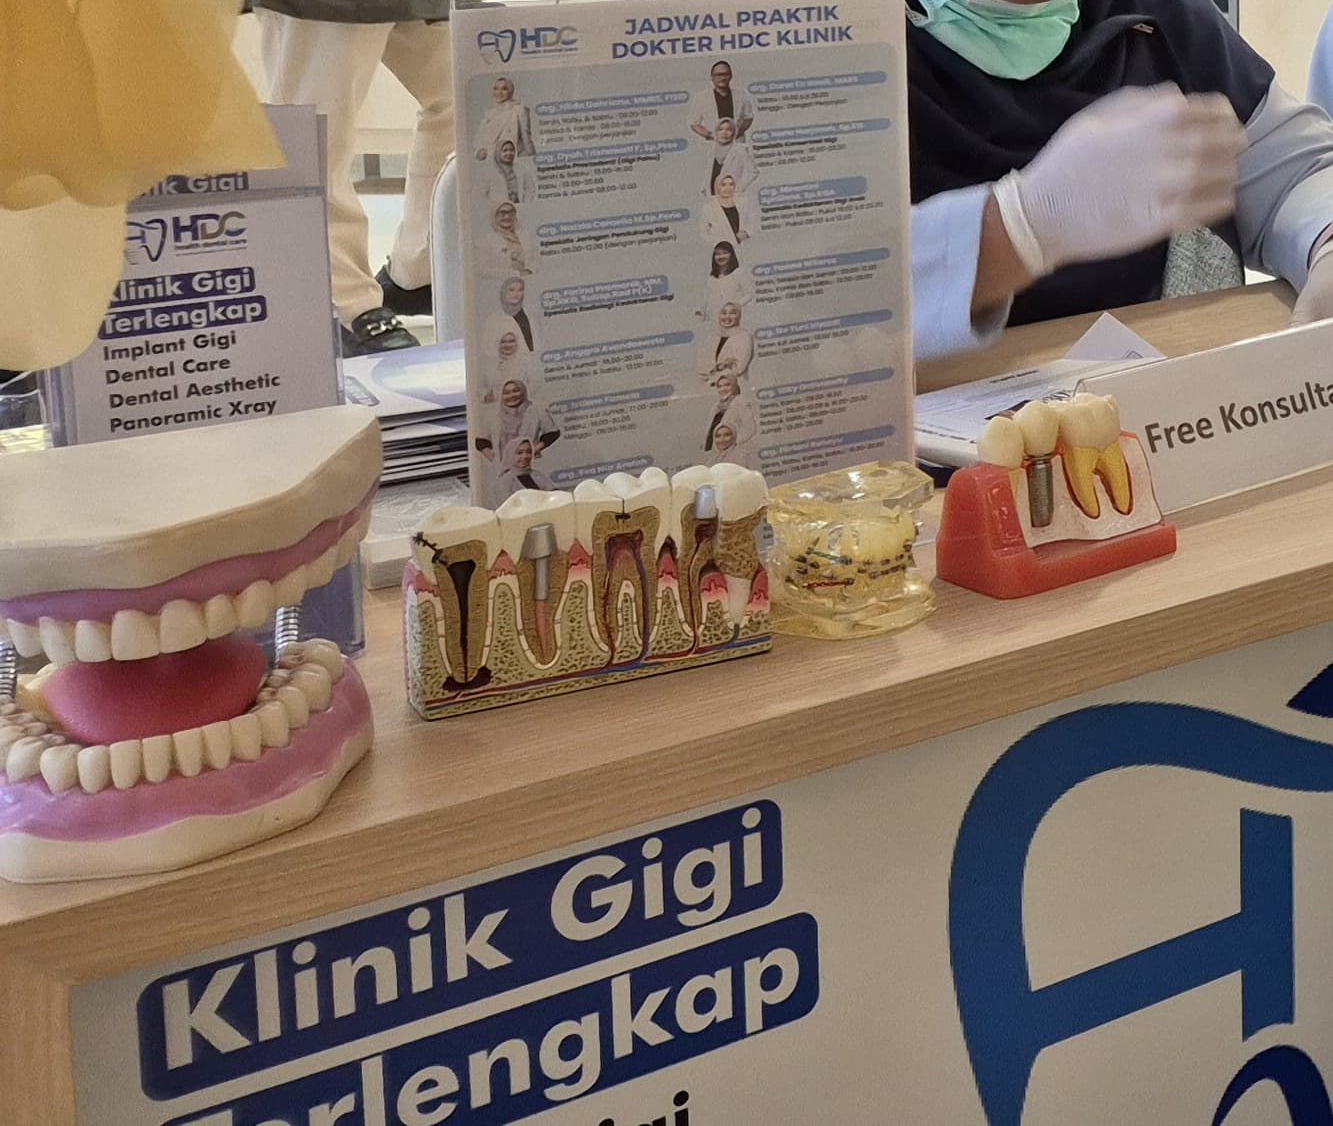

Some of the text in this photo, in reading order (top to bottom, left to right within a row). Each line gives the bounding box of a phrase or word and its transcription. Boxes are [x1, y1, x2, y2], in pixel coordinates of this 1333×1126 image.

[625, 5, 839, 35] JADWAL PRAKTIK
[520, 26, 577, 49] HDC
[612, 25, 853, 59] DOKTER HDC KLINIK
[172, 211, 246, 243] HDC
[191, 268, 251, 293] Gigi
[104, 301, 262, 334] Terlengkap
[104, 330, 236, 361] Implant Gigi
[106, 358, 231, 384] Dental Care
[109, 374, 280, 408] Dental Aesthetic
[110, 400, 277, 433] Panoramic Xray
[1144, 416, 1215, 454] Free
[162, 807, 765, 1071] Klinik Gigi
